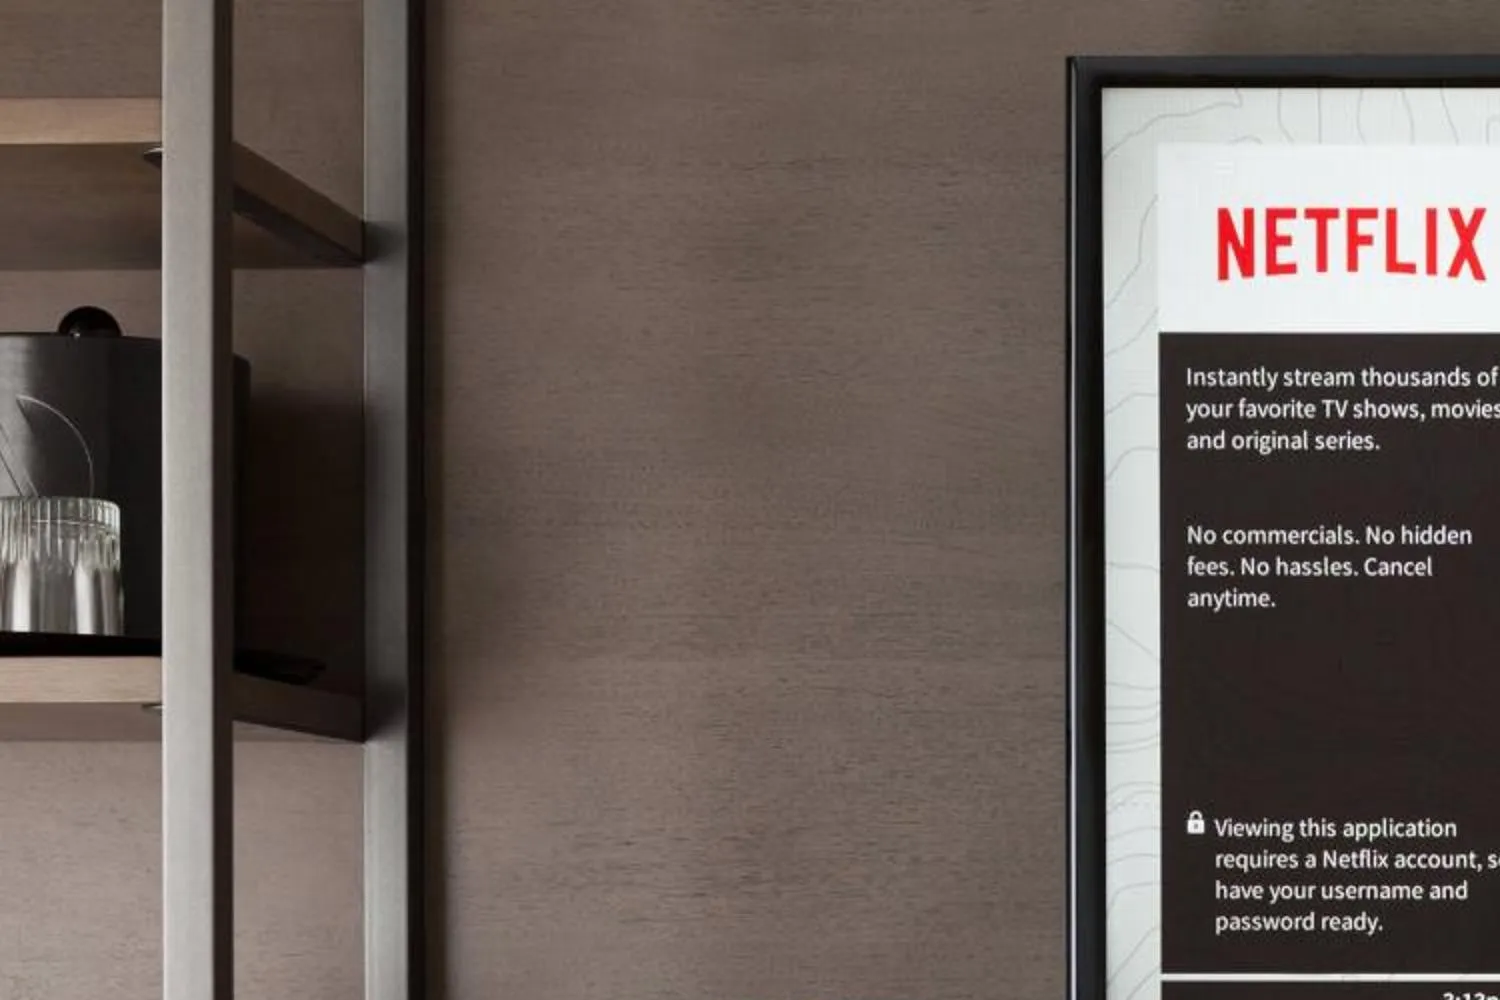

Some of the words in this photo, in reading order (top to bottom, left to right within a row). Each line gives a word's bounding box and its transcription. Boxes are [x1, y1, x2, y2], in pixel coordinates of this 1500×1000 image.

[1217, 207, 1486, 281] NETFLIX
[1187, 366, 1279, 392] Instantly
[1283, 369, 1355, 388] stream
[1360, 366, 1471, 388] thousands
[1476, 365, 1499, 387] of
[1186, 402, 1234, 423] your
[1239, 397, 1317, 419] favorite
[1321, 399, 1350, 419] TV
[1353, 398, 1426, 423] shows,
[1187, 429, 1226, 450] and
[1231, 429, 1309, 456] original
[1314, 430, 1380, 451] series.
[1187, 525, 1217, 545] No
[1222, 524, 1360, 545] commercials.
[1365, 525, 1395, 545] No
[1401, 524, 1473, 545] hidden
[1187, 555, 1235, 577] fees.
[1240, 557, 1270, 577] No
[1275, 555, 1359, 577] hassles.
[1363, 555, 1433, 577] Cancel
[1187, 587, 1276, 613] anytime.
[1214, 817, 1295, 843] Viewing
[1299, 817, 1337, 838] this
[1342, 817, 1457, 843] application
[1215, 849, 1299, 873] requires
[1304, 853, 1317, 869] a
[1322, 848, 1389, 869] Netflix
[1394, 851, 1483, 873] account,
[1215, 879, 1265, 900] have
[1268, 884, 1317, 905] your
[1321, 884, 1424, 900] username
[1429, 879, 1468, 900] and
[1215, 911, 1316, 936] password
[1320, 911, 1384, 936] ready.
